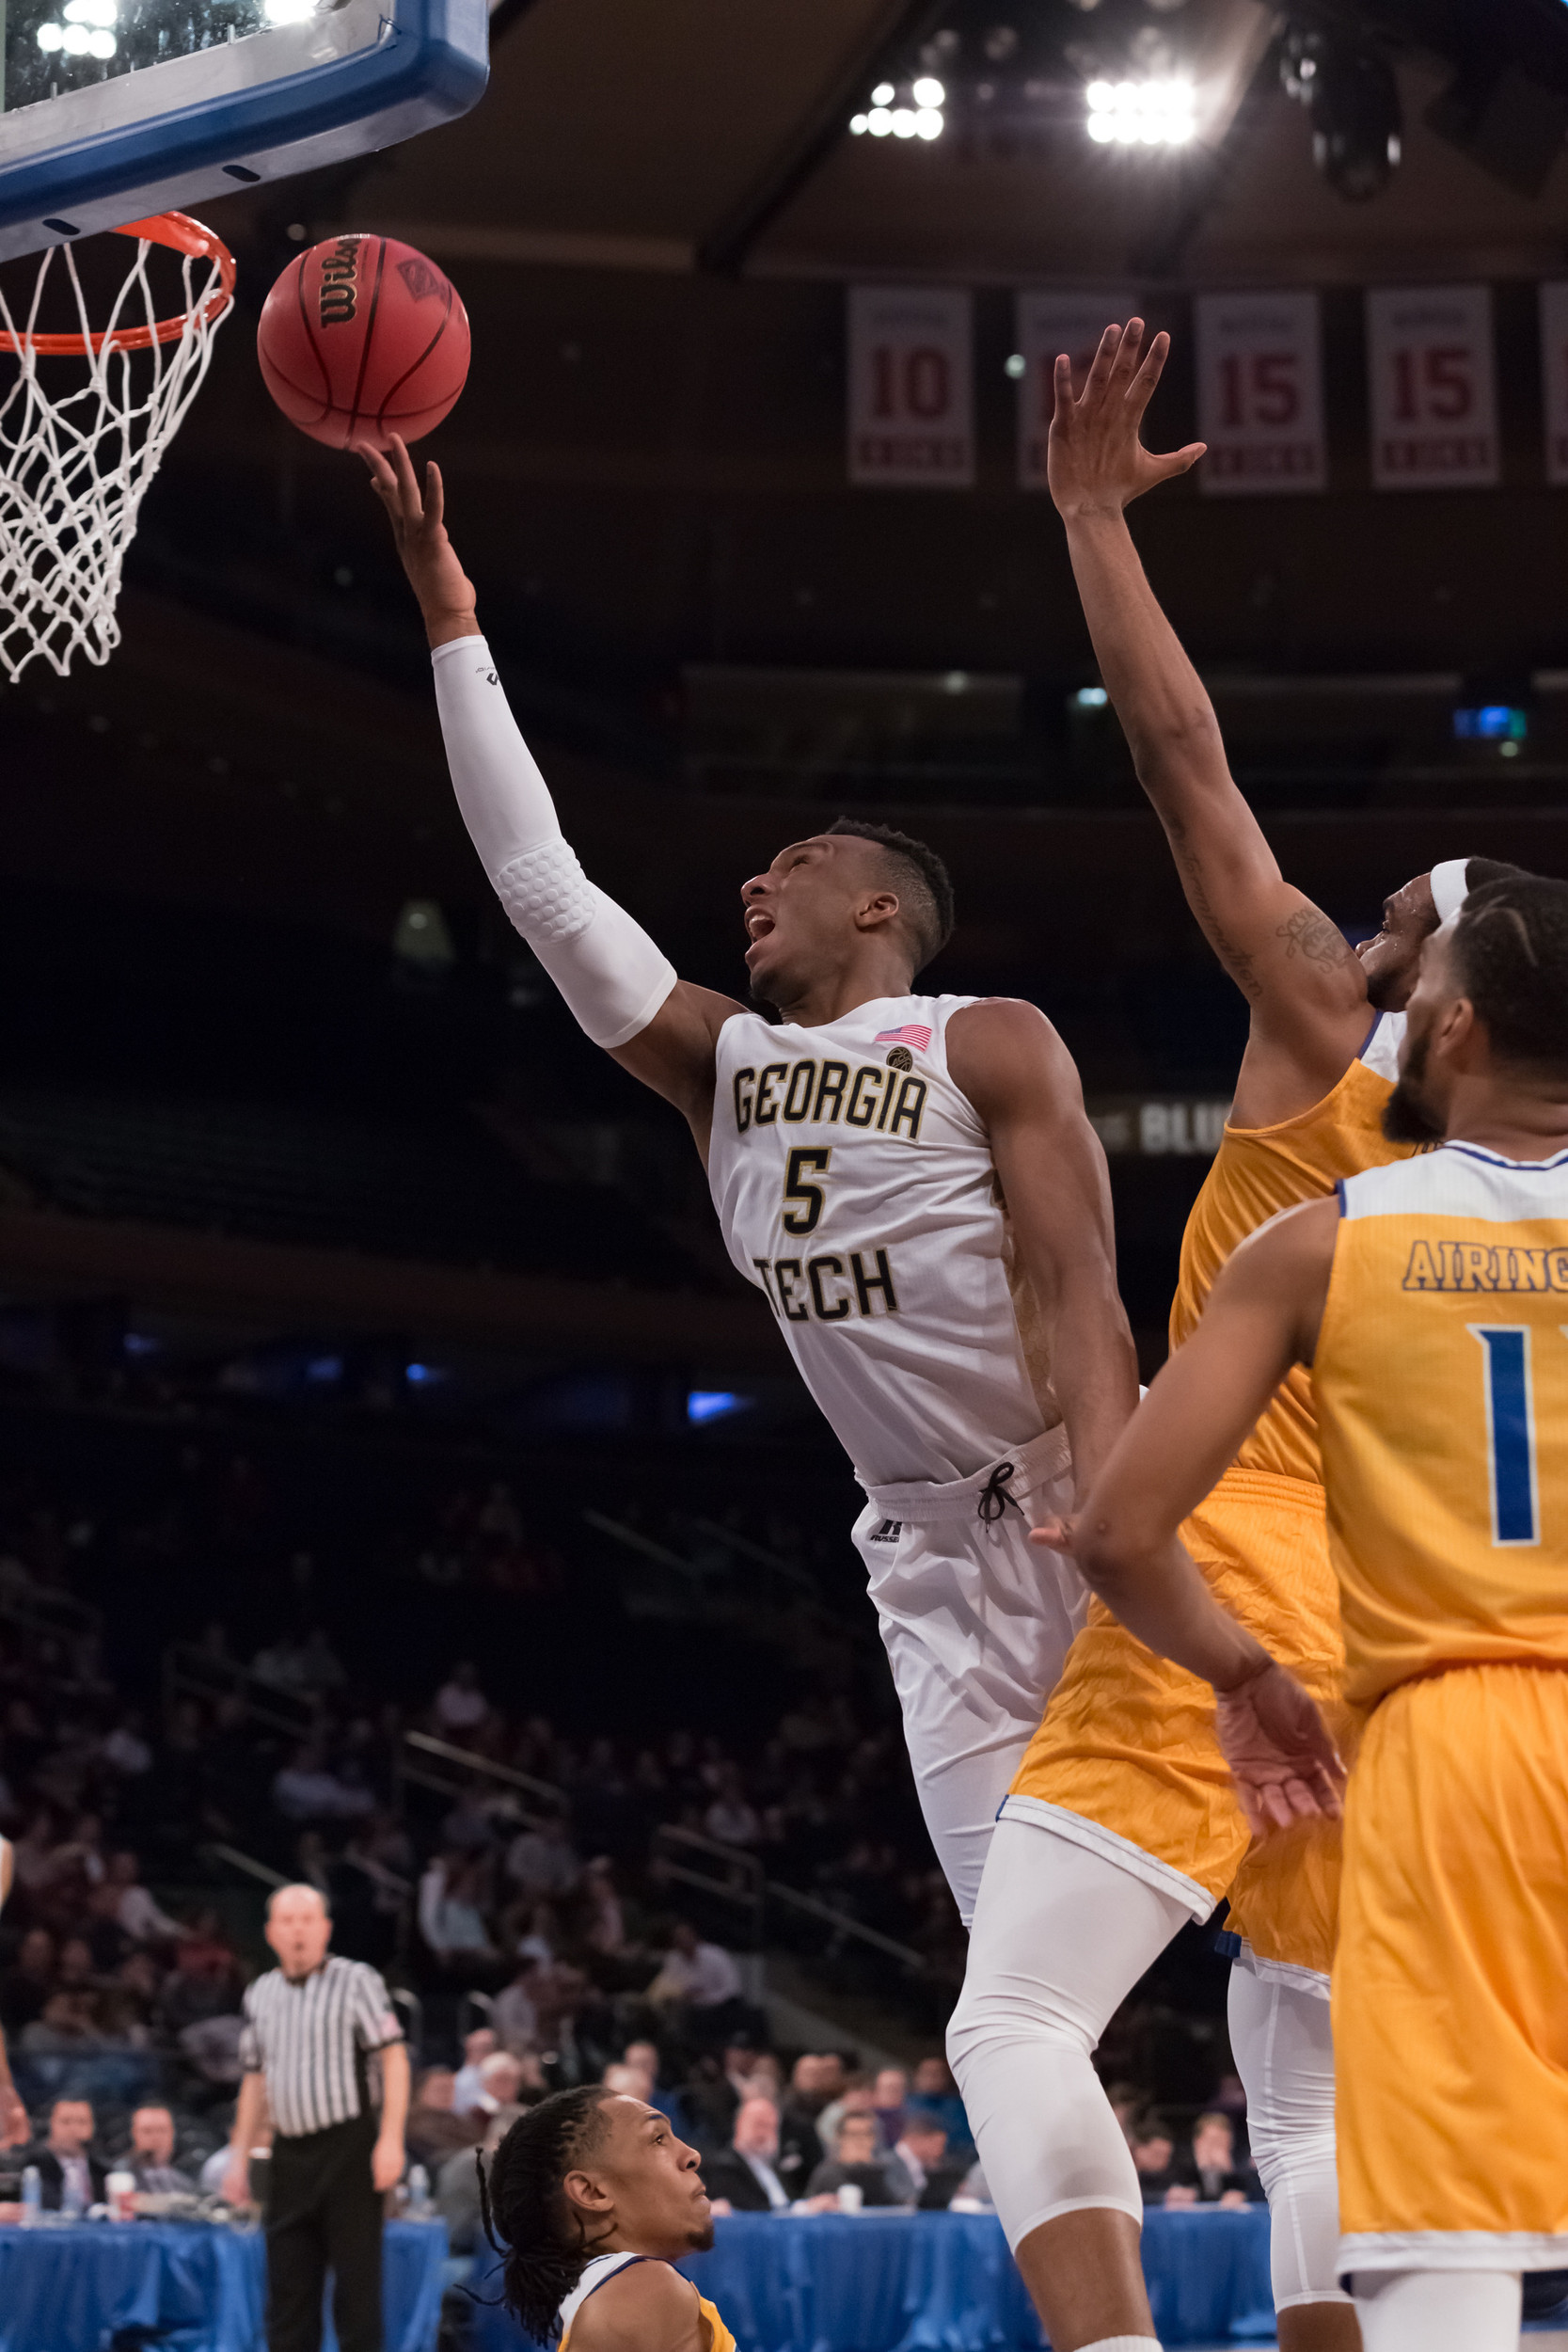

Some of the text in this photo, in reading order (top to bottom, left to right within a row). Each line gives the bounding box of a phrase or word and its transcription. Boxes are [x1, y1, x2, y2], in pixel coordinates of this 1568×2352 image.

[319, 235, 362, 328] Wilso
[872, 346, 950, 419] 10
[1222, 354, 1300, 427] 15
[1394, 348, 1473, 421] 15
[733, 1058, 929, 1143] GEORGIA
[1139, 1103, 1231, 1153] BLU
[782, 1146, 832, 1238] 5
[752, 1247, 898, 1321] TECH
[1465, 1323, 1568, 1548] 1
[870, 1534, 900, 1543] RUSSE
